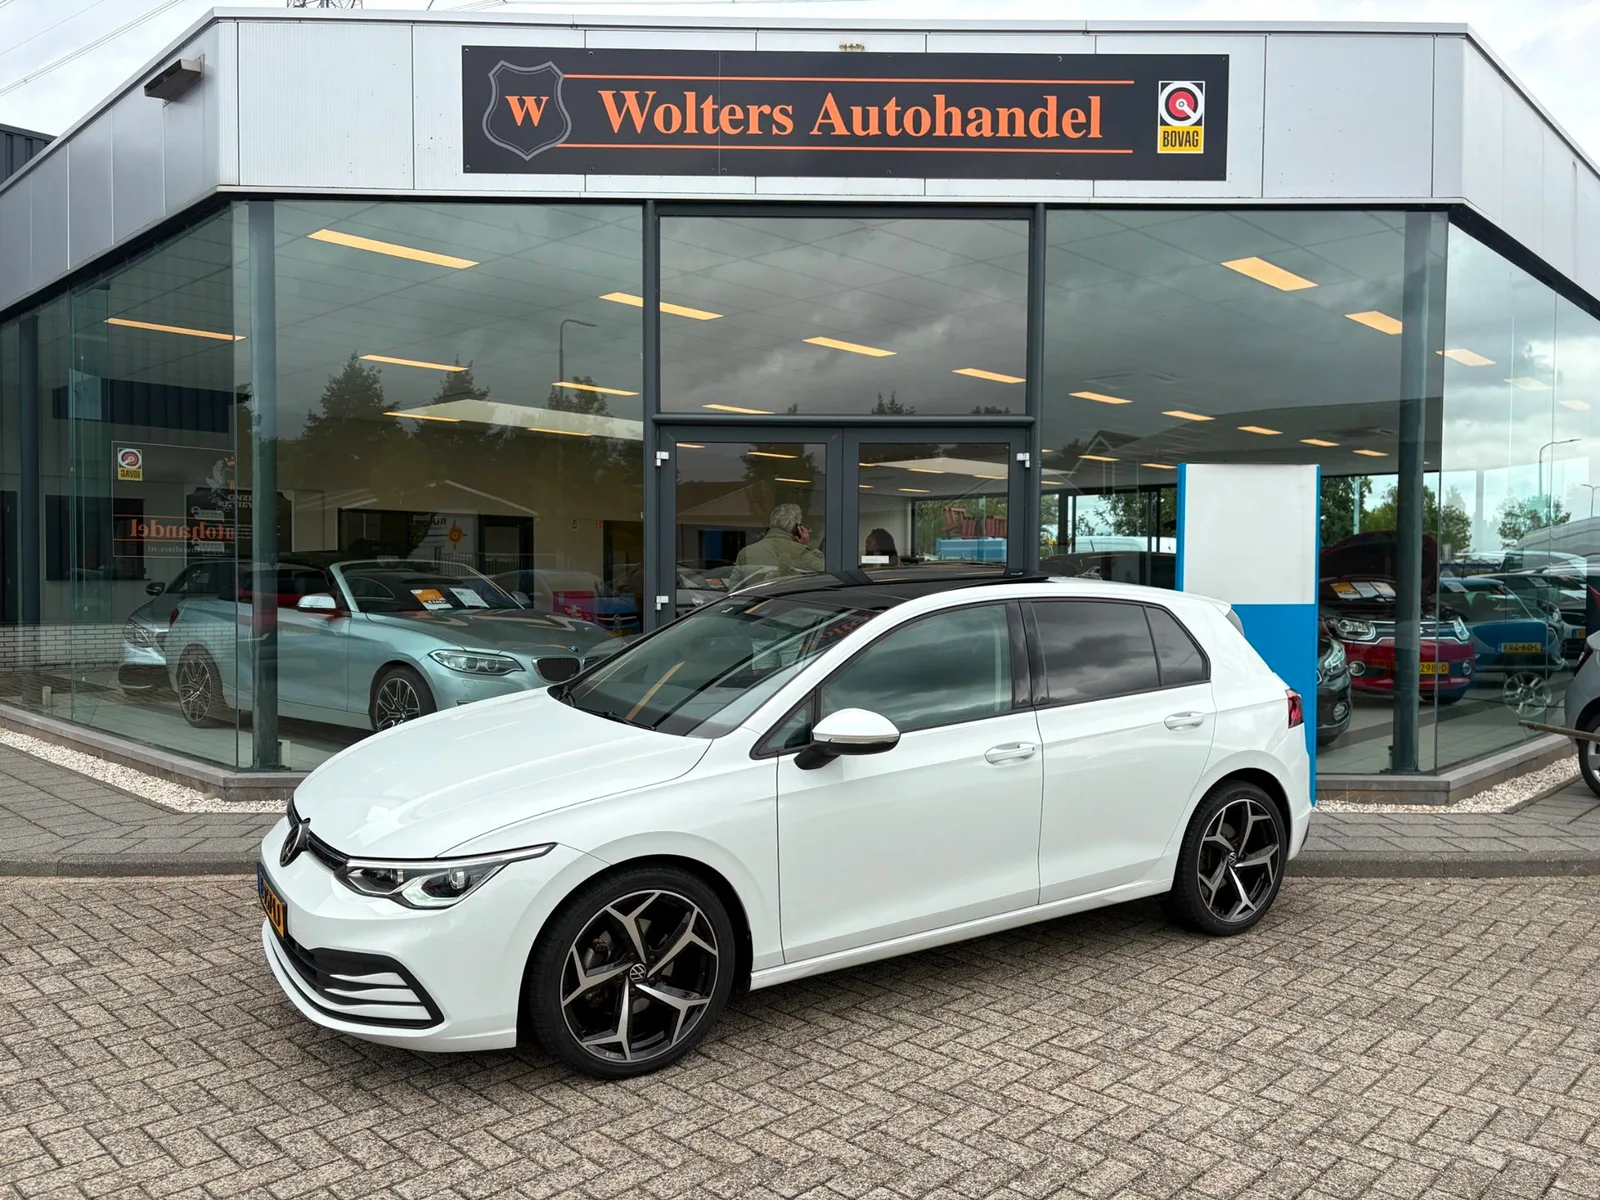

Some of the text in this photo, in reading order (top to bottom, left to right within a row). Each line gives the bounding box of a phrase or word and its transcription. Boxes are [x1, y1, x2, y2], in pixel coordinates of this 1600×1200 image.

[504, 95, 550, 127] W
[597, 89, 1103, 139] Wolters Autohandel
[1162, 129, 1200, 148] BOVAG
